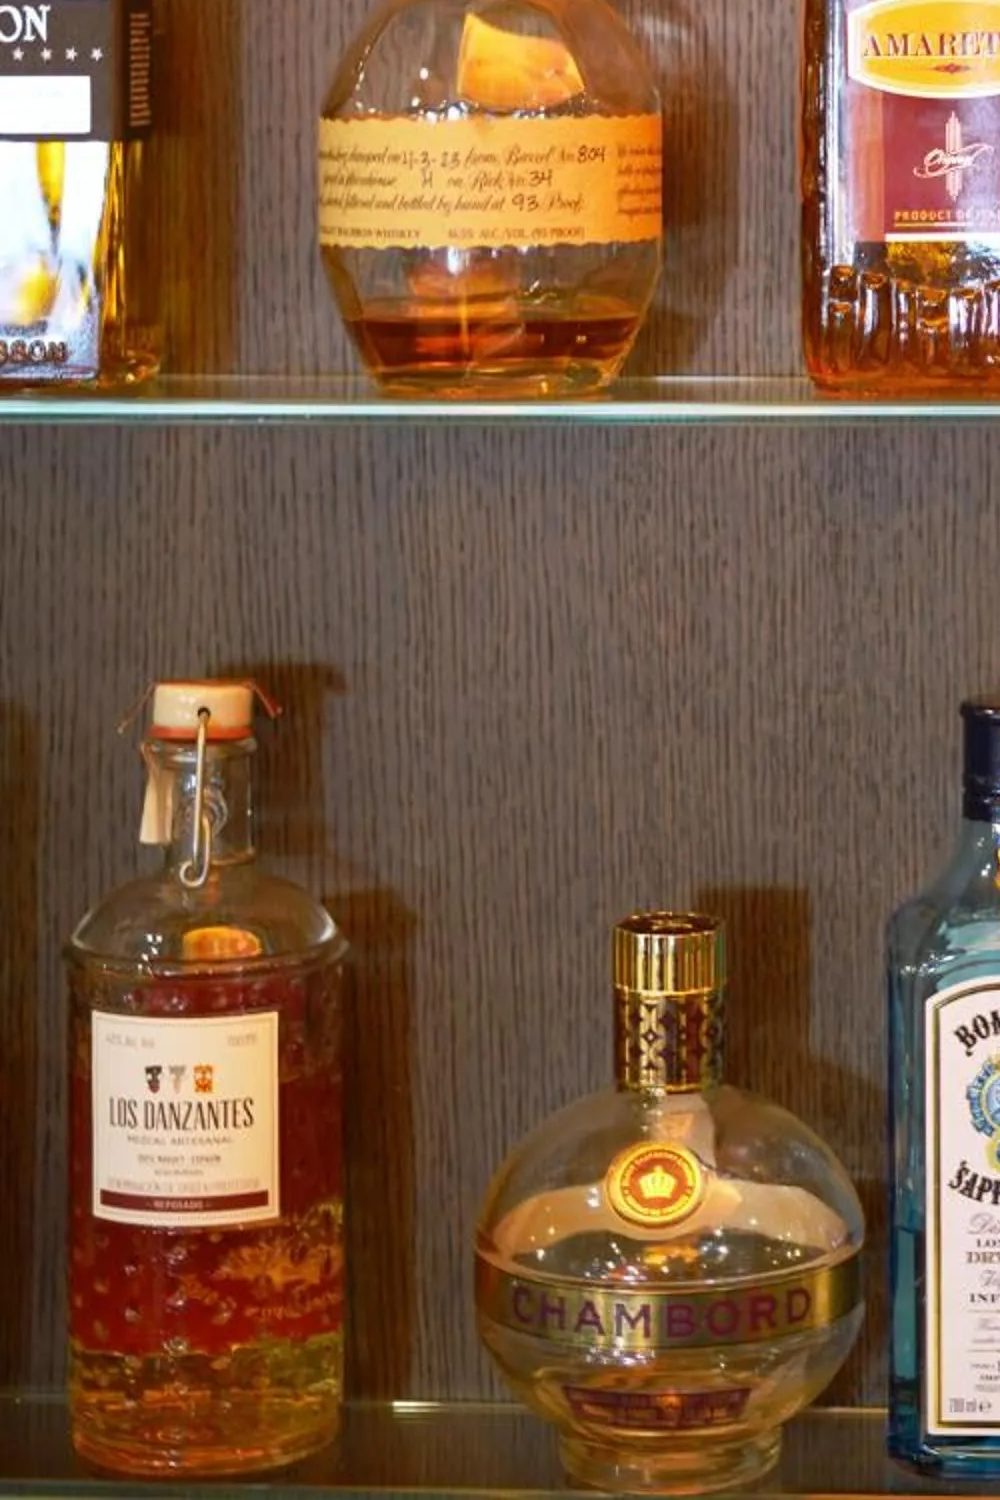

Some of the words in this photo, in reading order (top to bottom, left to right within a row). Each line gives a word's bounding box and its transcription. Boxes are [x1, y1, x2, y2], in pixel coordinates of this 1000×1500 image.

[576, 144, 607, 164] 804
[529, 168, 554, 188] 34
[511, 193, 540, 213] 93
[895, 209, 952, 221] PRODUCT
[109, 1097, 138, 1128] LOS
[143, 1097, 255, 1131] DANZANTES
[511, 1285, 814, 1340] CHAMBORD
